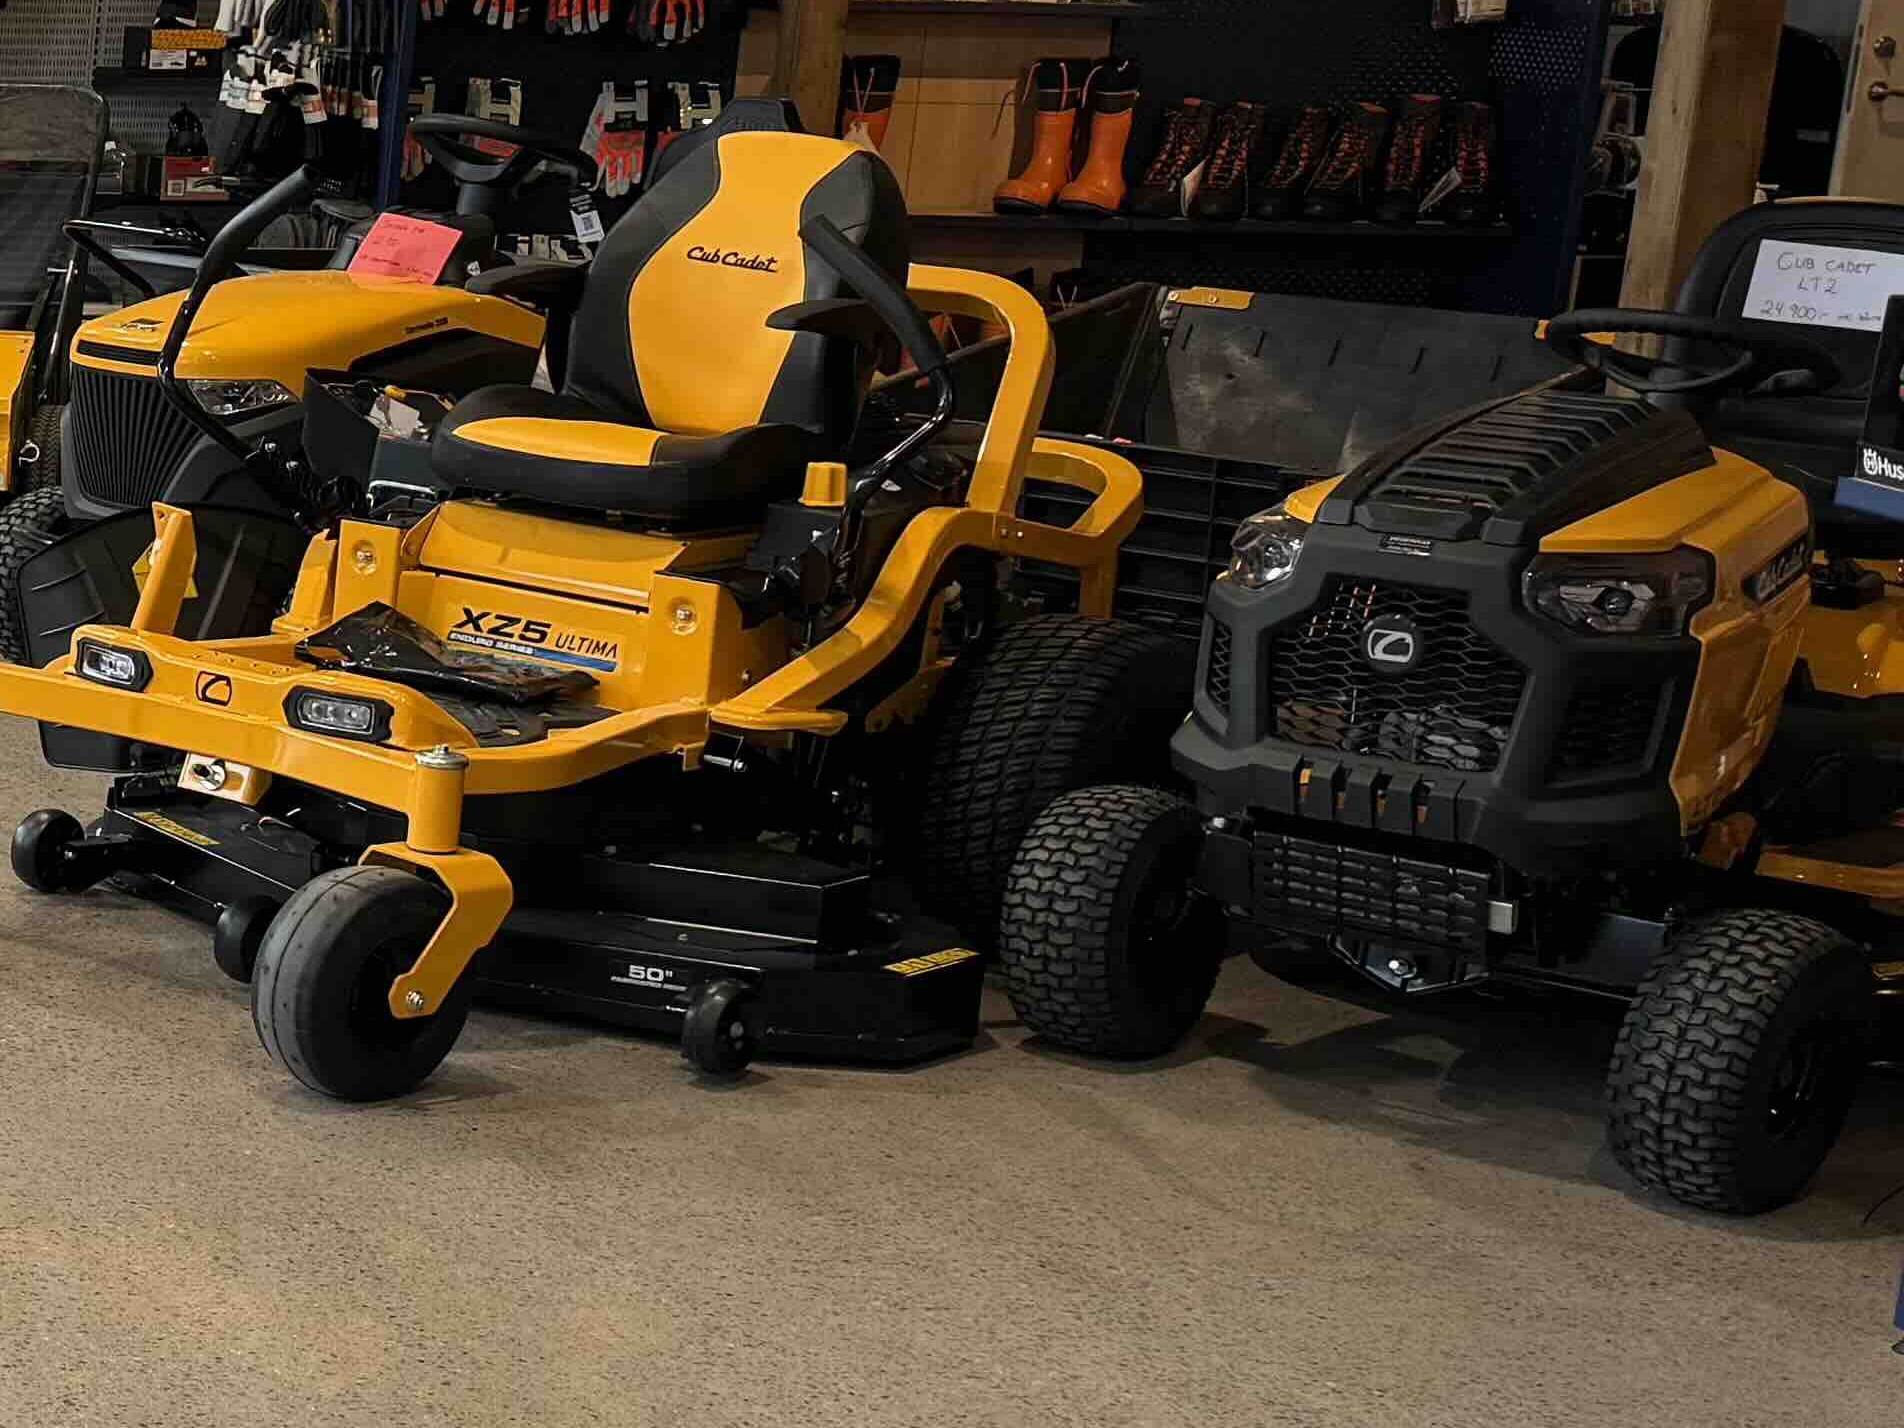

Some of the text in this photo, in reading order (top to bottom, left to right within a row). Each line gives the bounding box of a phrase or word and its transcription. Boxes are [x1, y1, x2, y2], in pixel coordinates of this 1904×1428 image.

[687, 246, 778, 273] Cub Cadet
[1824, 260, 1877, 276] CADET
[452, 606, 552, 644] XZ5
[554, 631, 619, 659] ULTIMA
[628, 964, 673, 983] 50"
